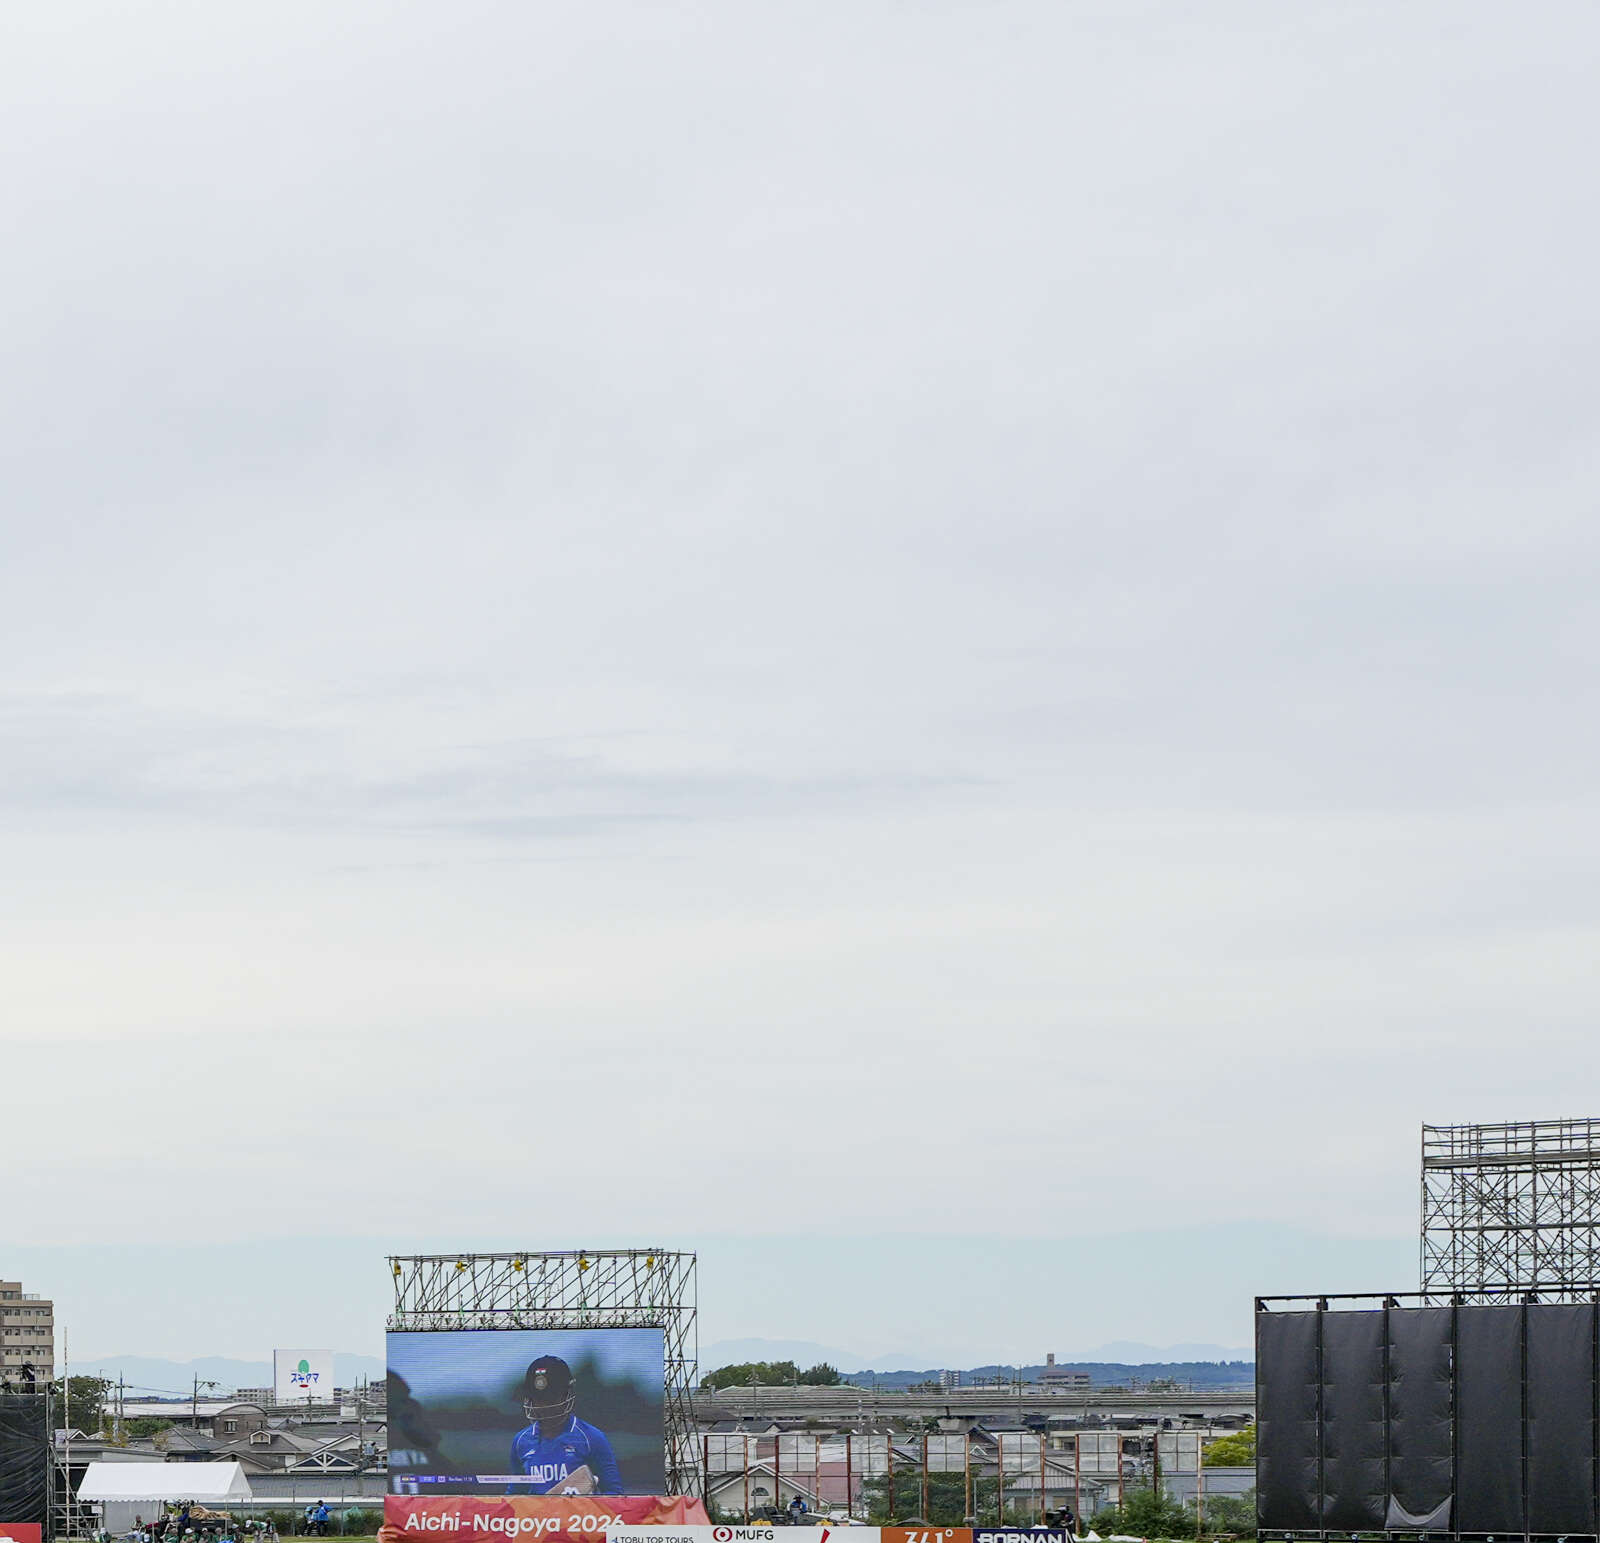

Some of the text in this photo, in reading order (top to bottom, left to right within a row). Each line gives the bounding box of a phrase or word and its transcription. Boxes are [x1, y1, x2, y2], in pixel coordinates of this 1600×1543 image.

[530, 1463, 569, 1482] INDIA
[403, 1511, 561, 1538] Aichi-Nagoya
[735, 1529, 774, 1541] MUFG
